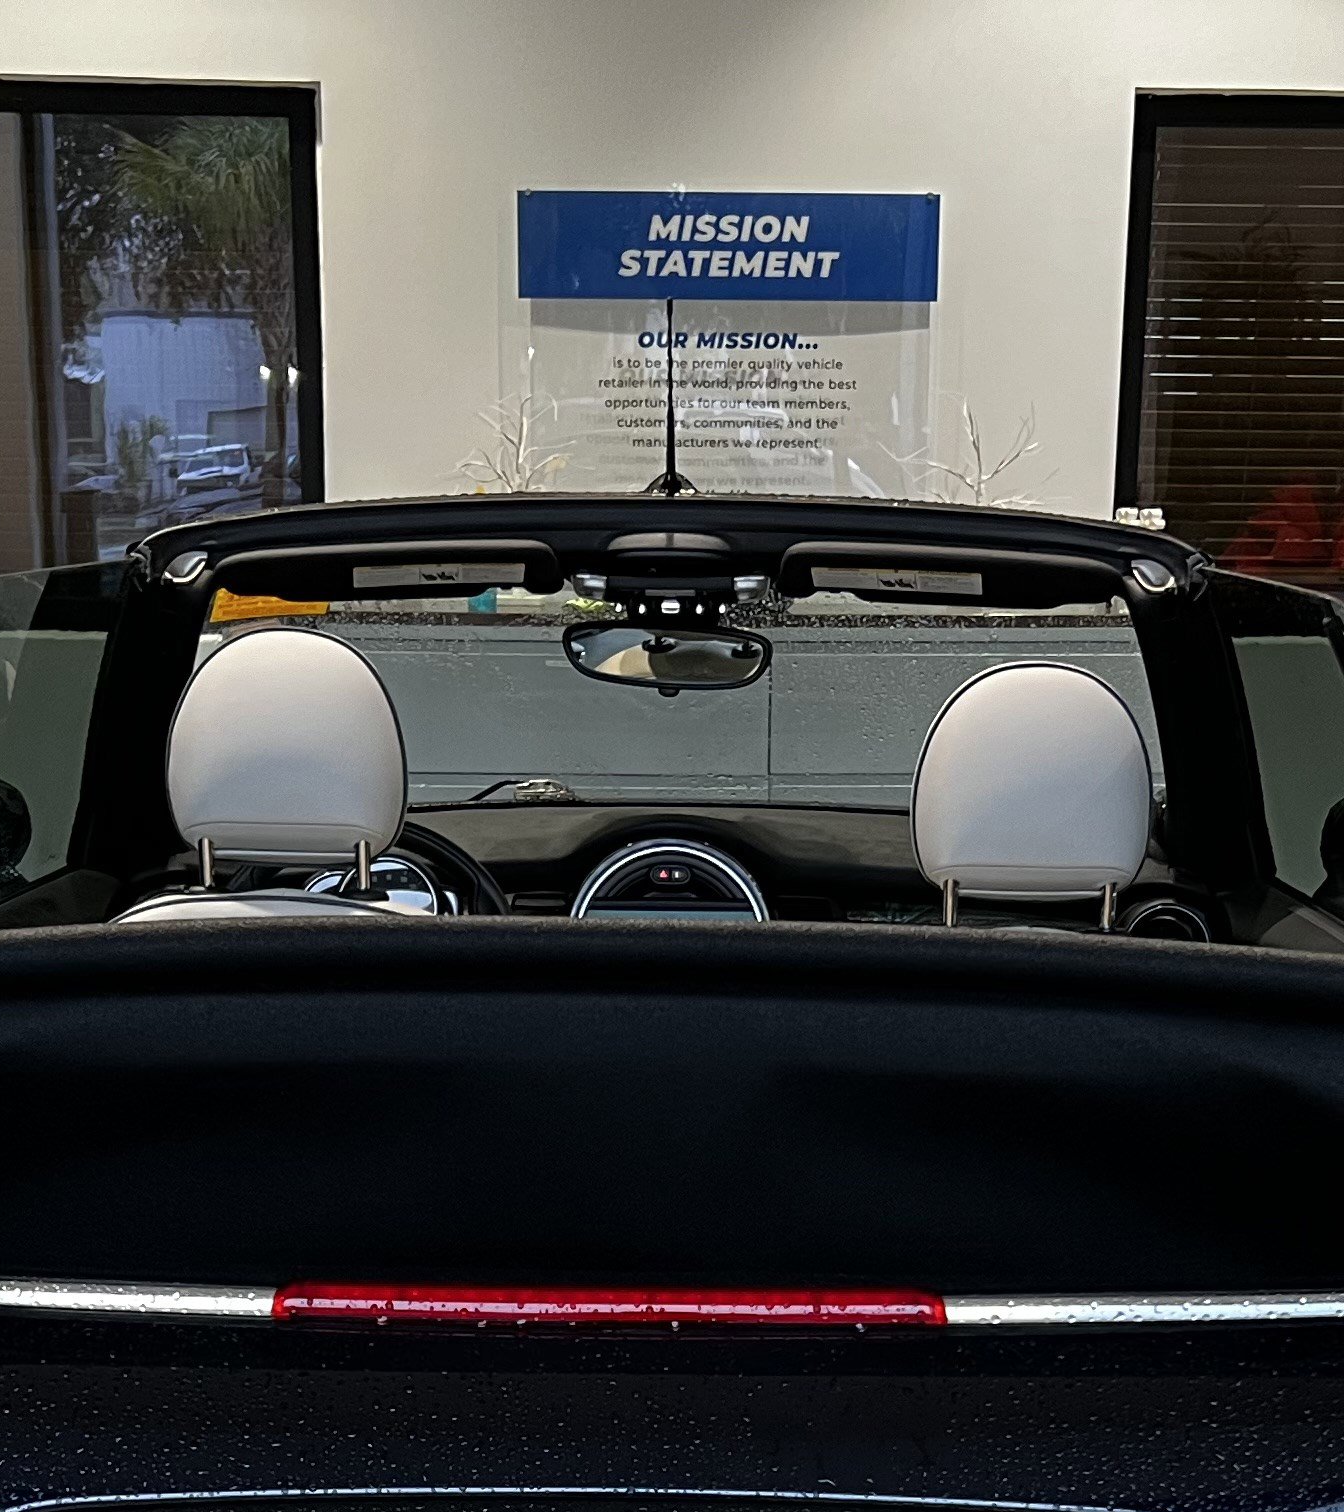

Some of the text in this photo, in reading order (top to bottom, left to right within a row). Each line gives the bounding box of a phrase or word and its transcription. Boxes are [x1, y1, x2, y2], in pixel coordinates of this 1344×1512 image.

[648, 214, 810, 243] MISSION
[618, 249, 840, 278] STATEMENT
[637, 331, 818, 350] OUR MISSION...
[612, 357, 624, 369] is
[627, 358, 641, 369] to
[644, 357, 662, 369] be
[692, 357, 744, 371] premier
[747, 358, 793, 373] quality
[797, 358, 844, 371] vehicle
[598, 378, 645, 389] retailer
[649, 377, 661, 389] in
[692, 379, 733, 391] world,
[736, 379, 798, 393] providing
[802, 379, 825, 390] the
[828, 379, 857, 390] best
[604, 397, 851, 411] opportunies for our team members,
[617, 417, 838, 430] customrs, communities, and the
[632, 437, 730, 448] manuacturers
[733, 439, 753, 448] we
